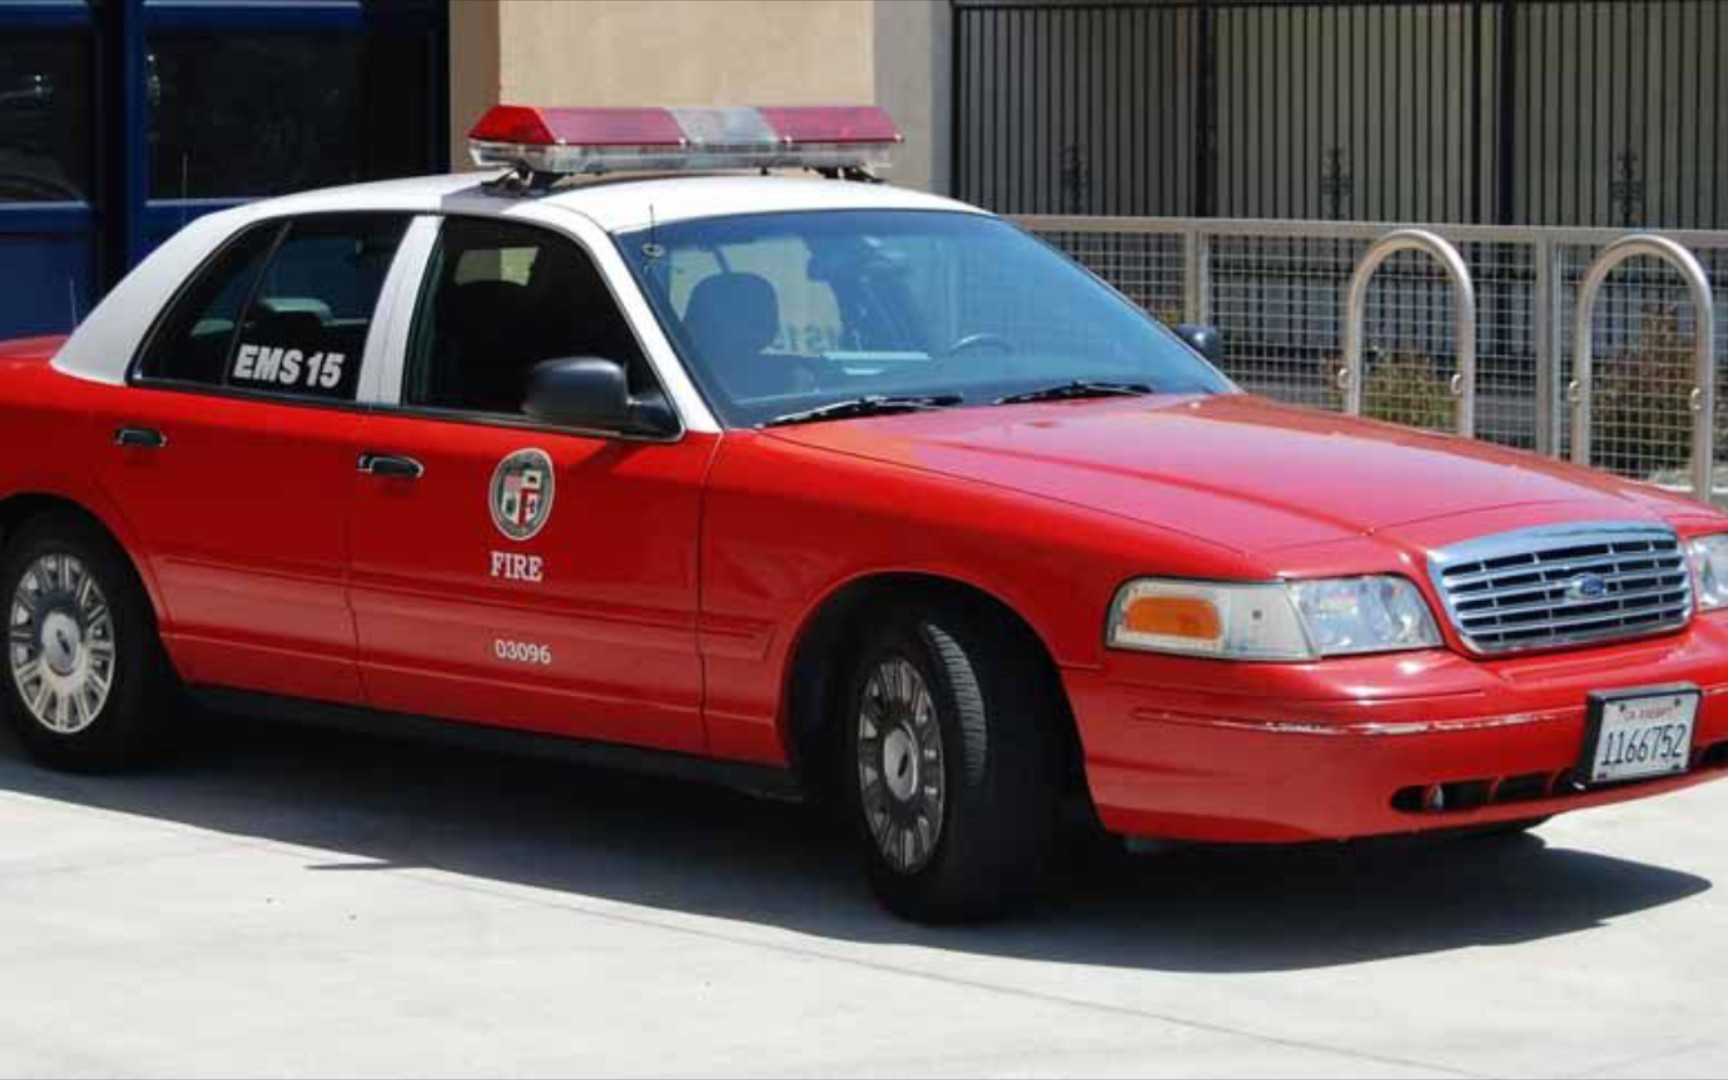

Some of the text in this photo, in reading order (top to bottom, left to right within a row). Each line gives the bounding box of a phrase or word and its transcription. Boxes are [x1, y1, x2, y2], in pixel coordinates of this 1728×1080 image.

[233, 344, 345, 388] EMS 15
[491, 552, 543, 582] FIRE
[495, 639, 551, 664] 03096
[1601, 723, 1687, 766] 1166752
